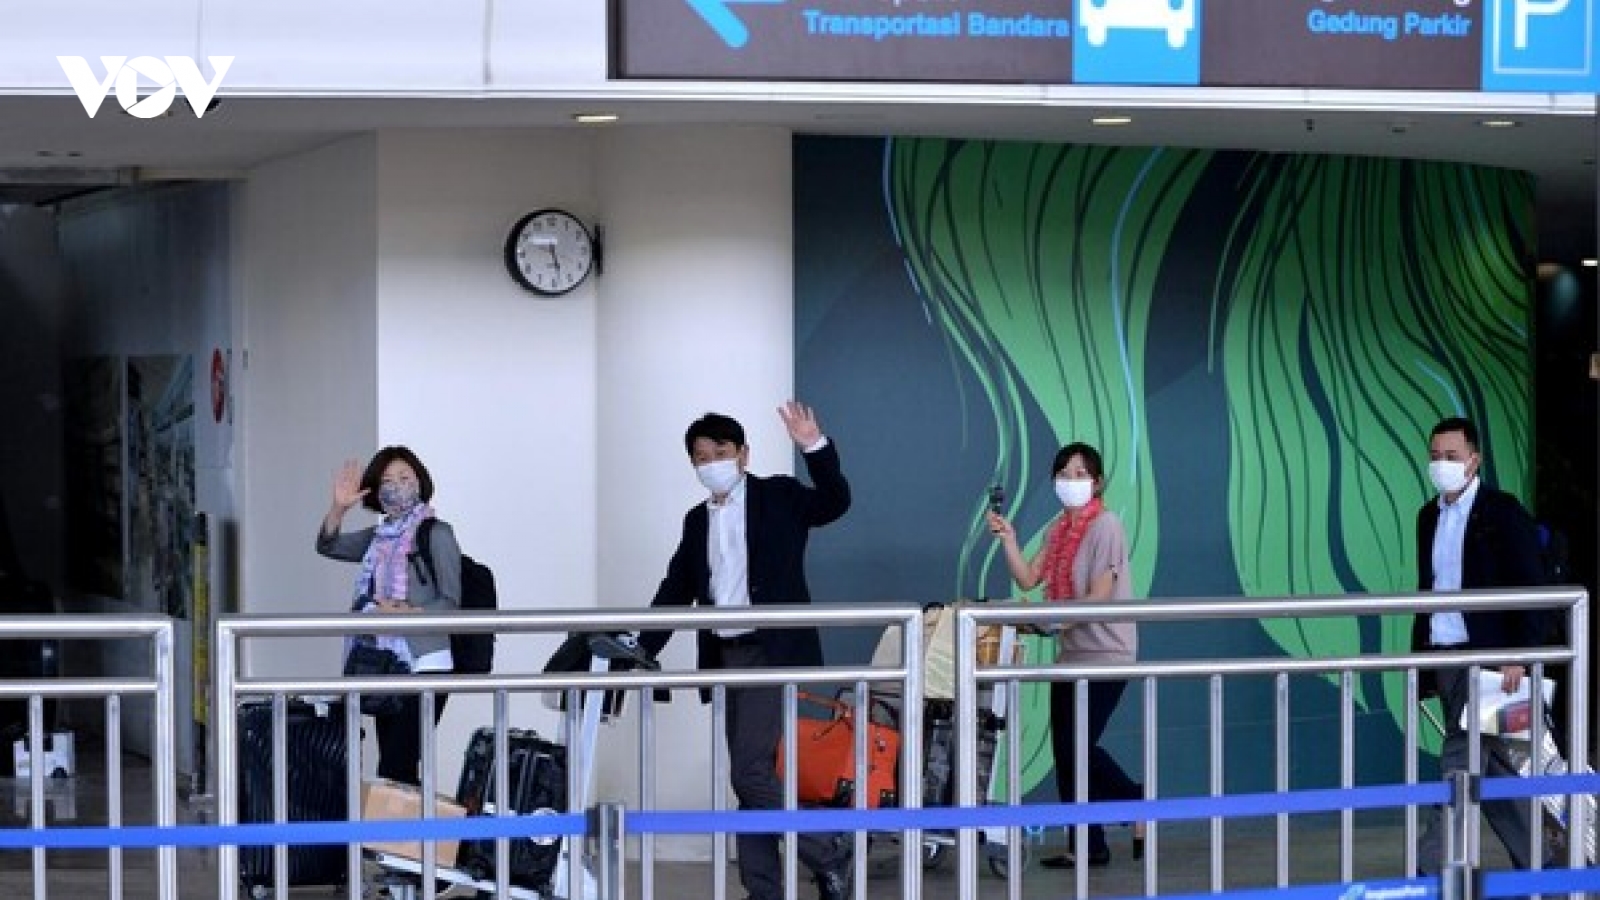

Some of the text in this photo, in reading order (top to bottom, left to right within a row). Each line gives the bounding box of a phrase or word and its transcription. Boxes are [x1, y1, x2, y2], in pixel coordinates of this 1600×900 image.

[803, 9, 1070, 41] Transportasi Bandara
[1308, 9, 1472, 40] Gedung Parkir
